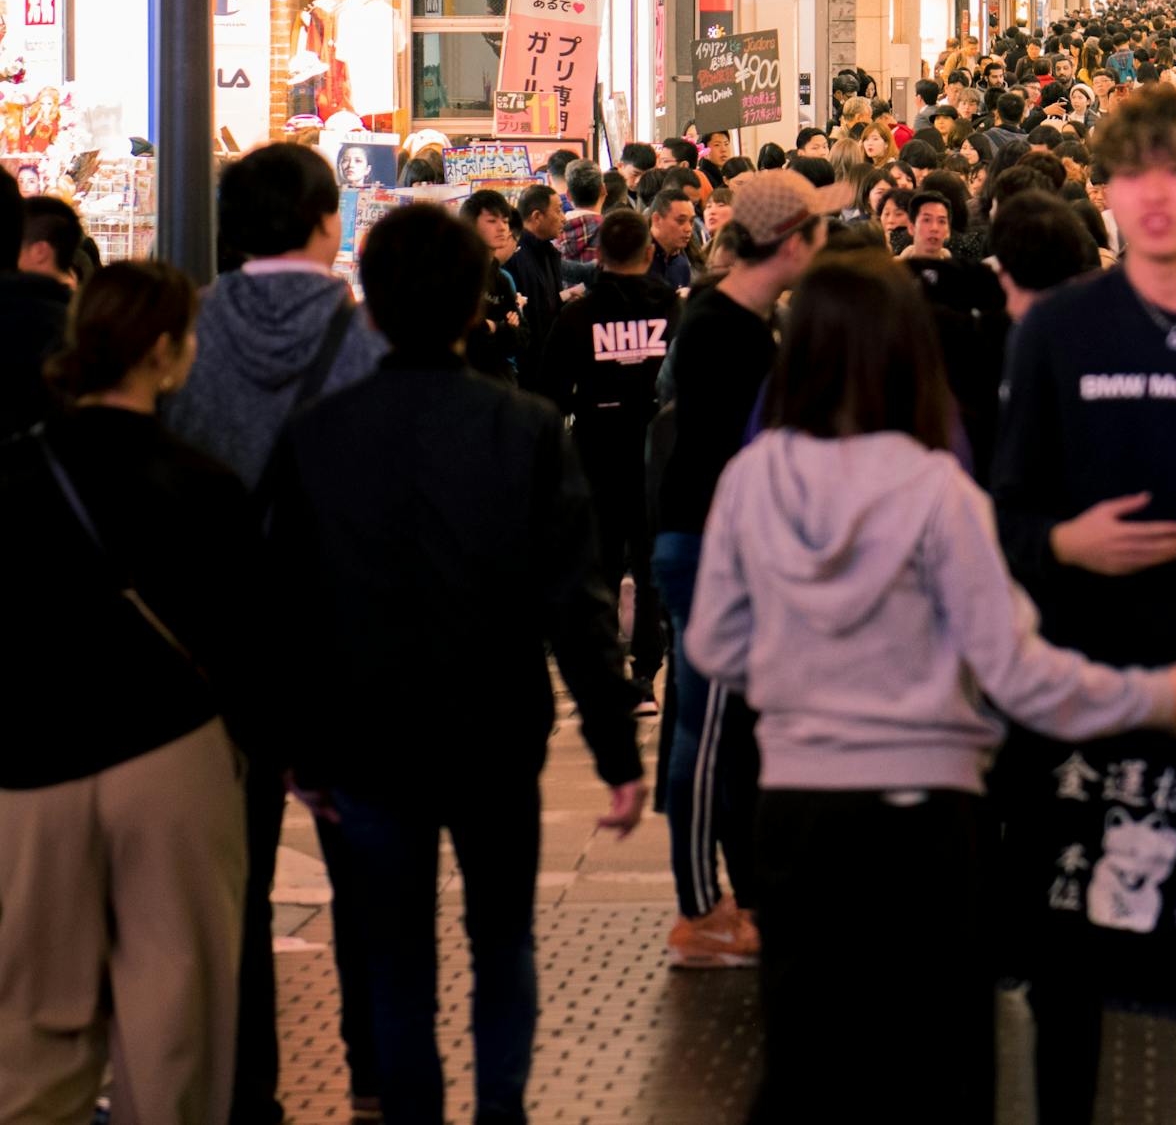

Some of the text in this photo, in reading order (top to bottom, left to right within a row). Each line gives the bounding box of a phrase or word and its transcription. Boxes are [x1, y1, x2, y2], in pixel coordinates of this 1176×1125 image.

[733, 52, 781, 94] ¥900
[592, 318, 668, 353] NHIZ
[1081, 373, 1146, 400] BMW
